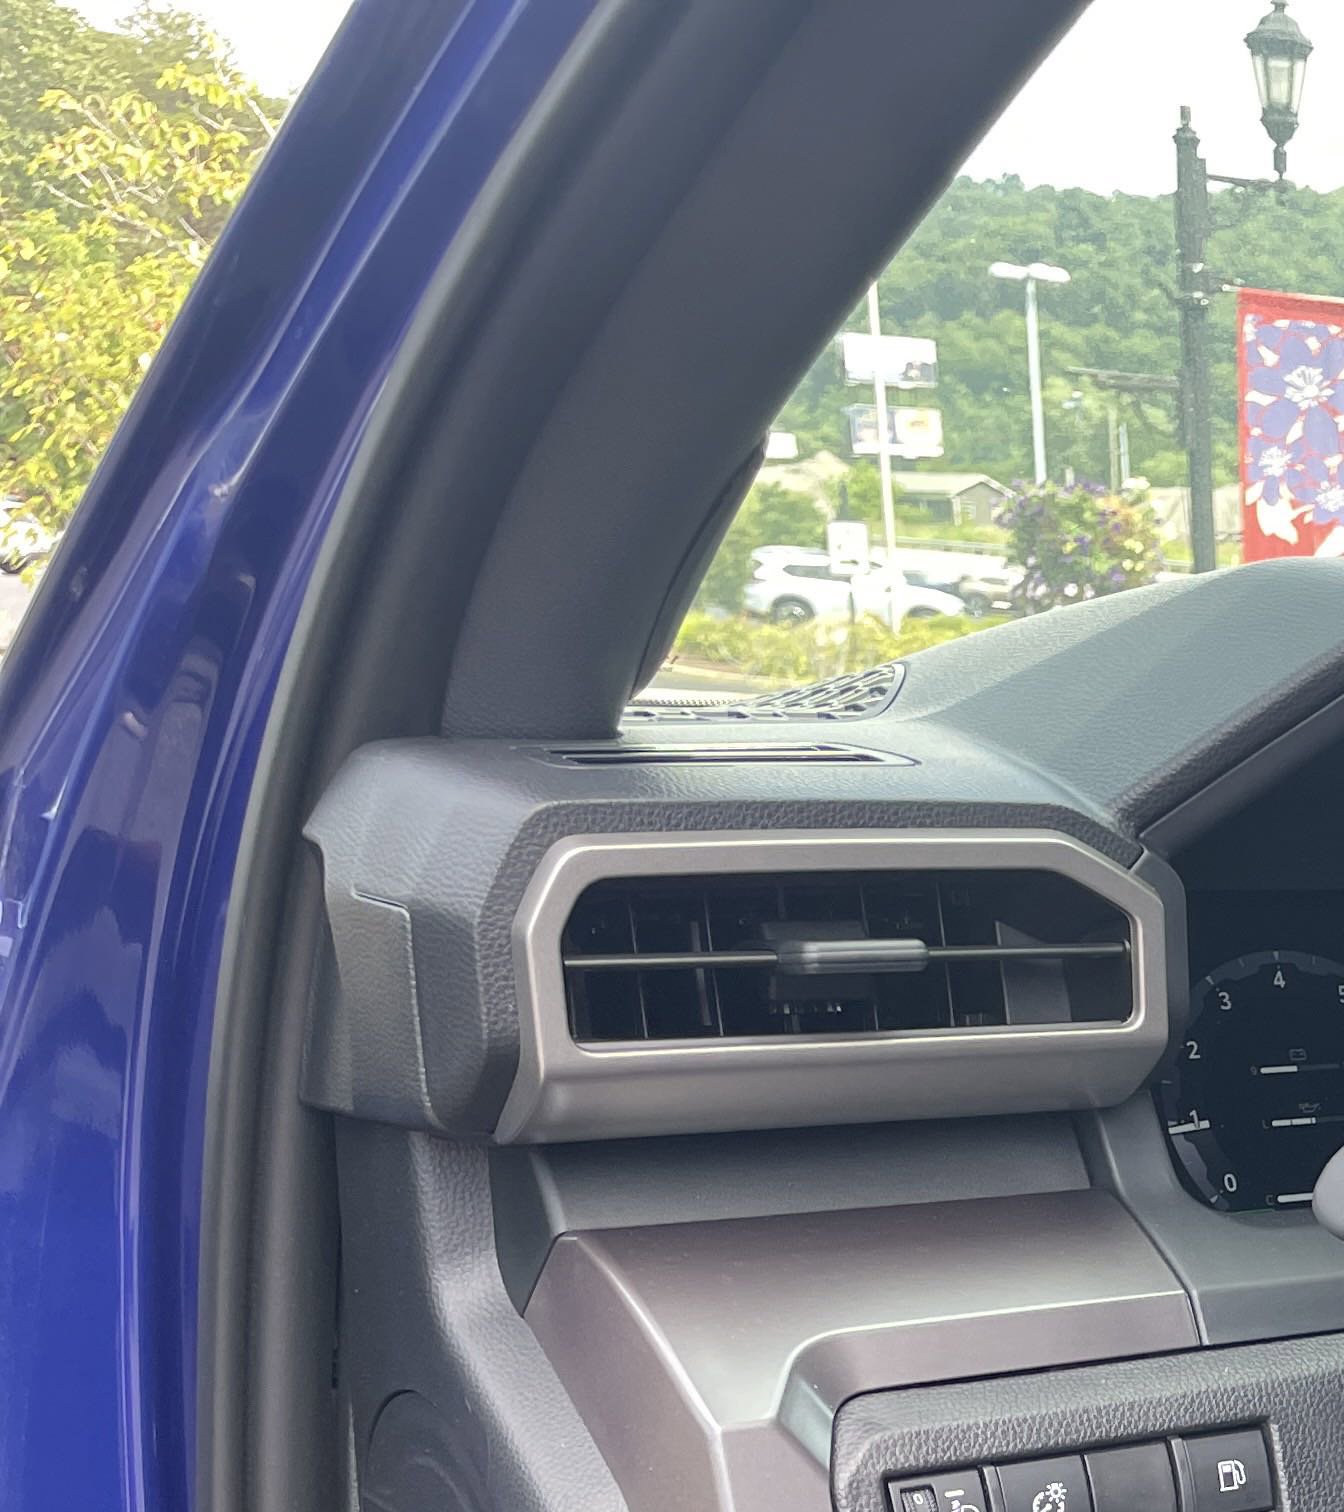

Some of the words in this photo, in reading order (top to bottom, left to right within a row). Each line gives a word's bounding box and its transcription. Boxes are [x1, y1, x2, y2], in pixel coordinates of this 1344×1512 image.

[1272, 970, 1286, 989] 4
[1218, 991, 1232, 1010] 3
[1185, 1040, 1201, 1060] 2
[1189, 1110, 1200, 1129] 1
[1223, 1172, 1238, 1192] 0
